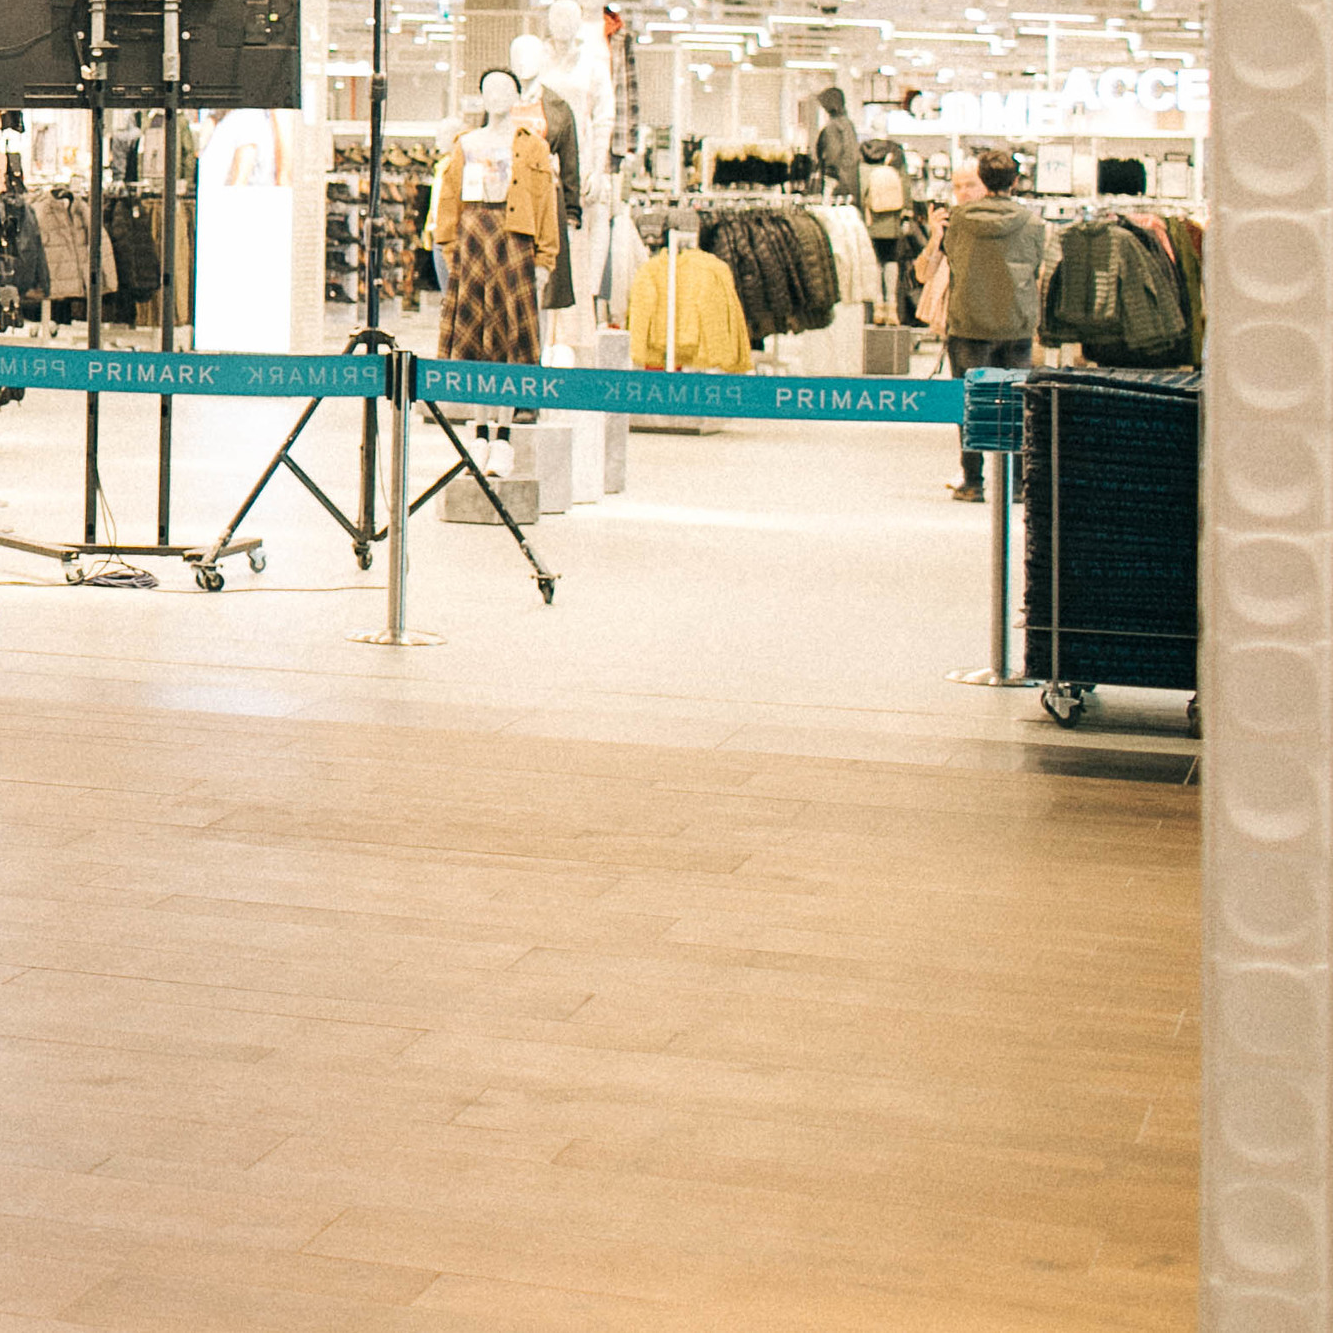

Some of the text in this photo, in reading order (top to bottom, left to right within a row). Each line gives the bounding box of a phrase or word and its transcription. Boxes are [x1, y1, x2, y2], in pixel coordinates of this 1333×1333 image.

[88, 361, 215, 385] PRIMARK
[425, 370, 560, 399] PRIMARK
[776, 387, 918, 413] PRIMARK
